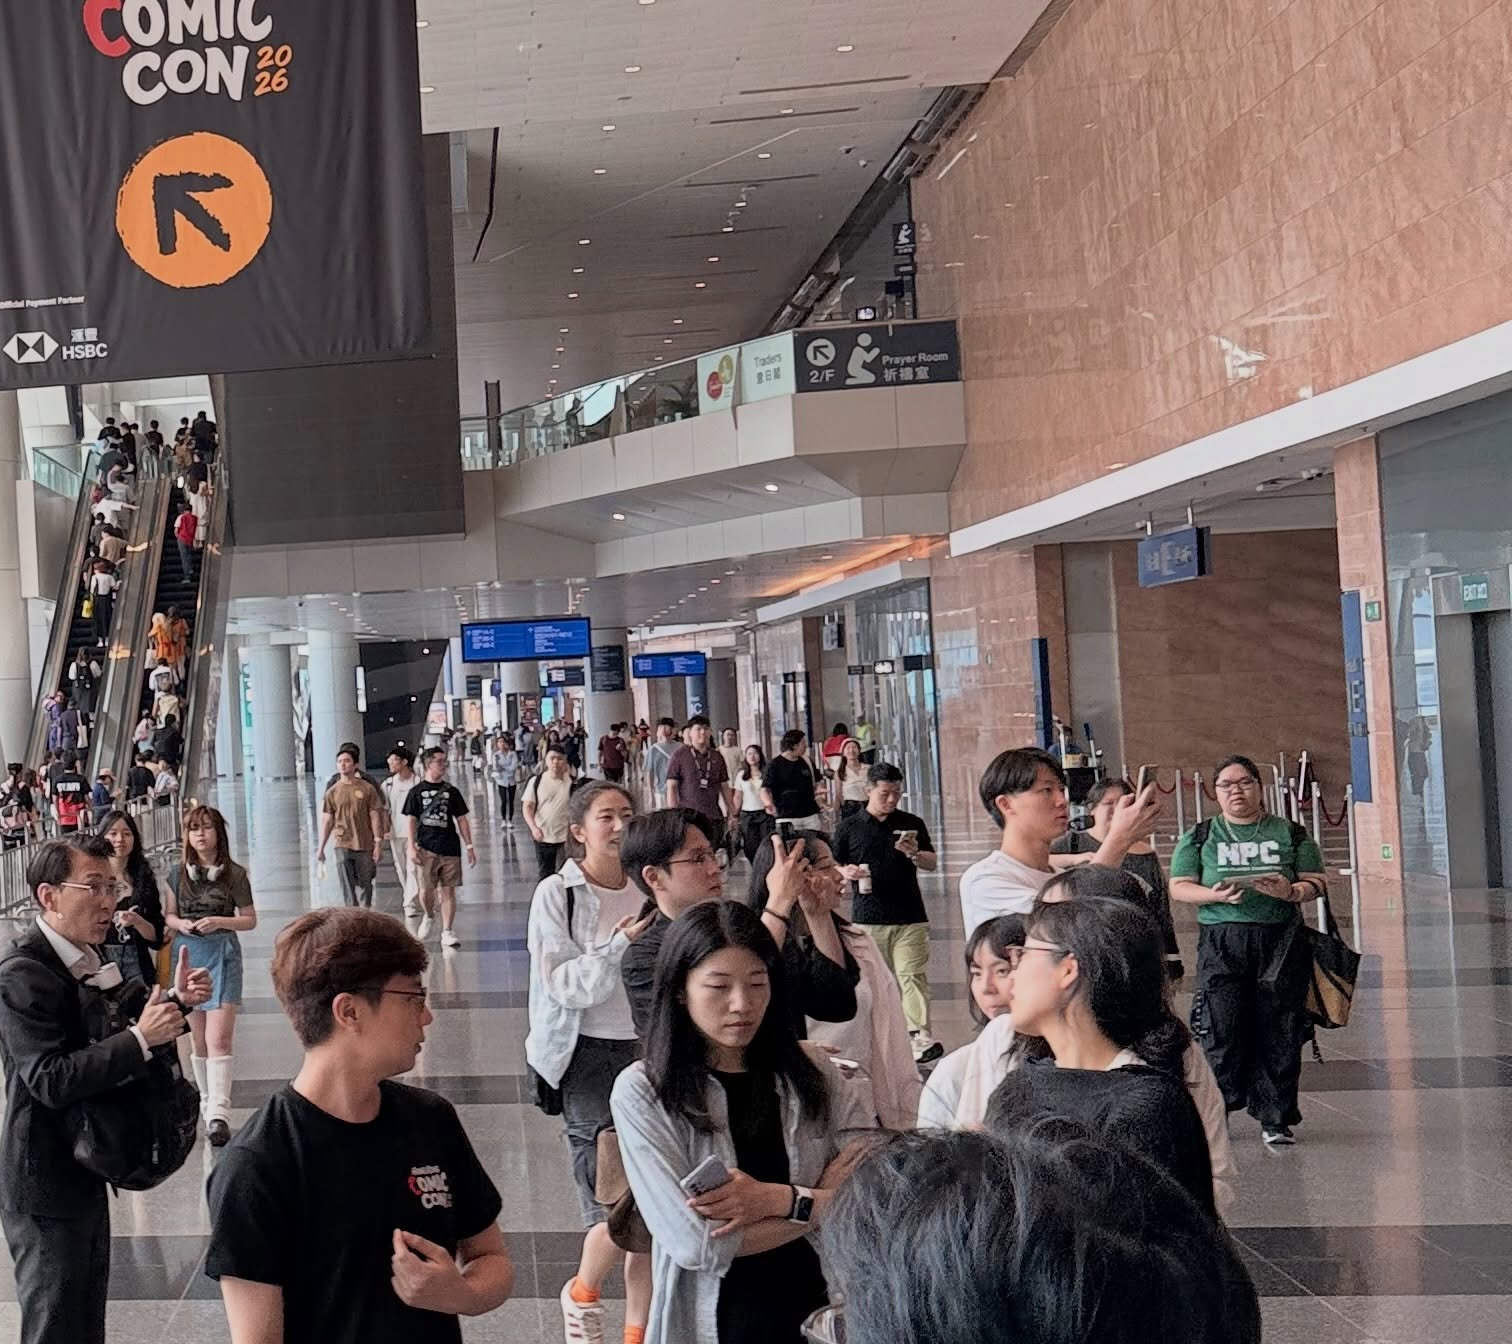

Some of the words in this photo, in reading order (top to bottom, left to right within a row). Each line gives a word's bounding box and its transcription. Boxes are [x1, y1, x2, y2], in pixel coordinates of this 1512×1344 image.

[256, 45, 292, 70] 20
[122, 45, 250, 106] CON
[253, 68, 289, 97] 26
[62, 343, 108, 360] HSBC
[881, 355, 916, 367] Prayer
[918, 352, 949, 363] Room
[808, 368, 836, 384] 2/F
